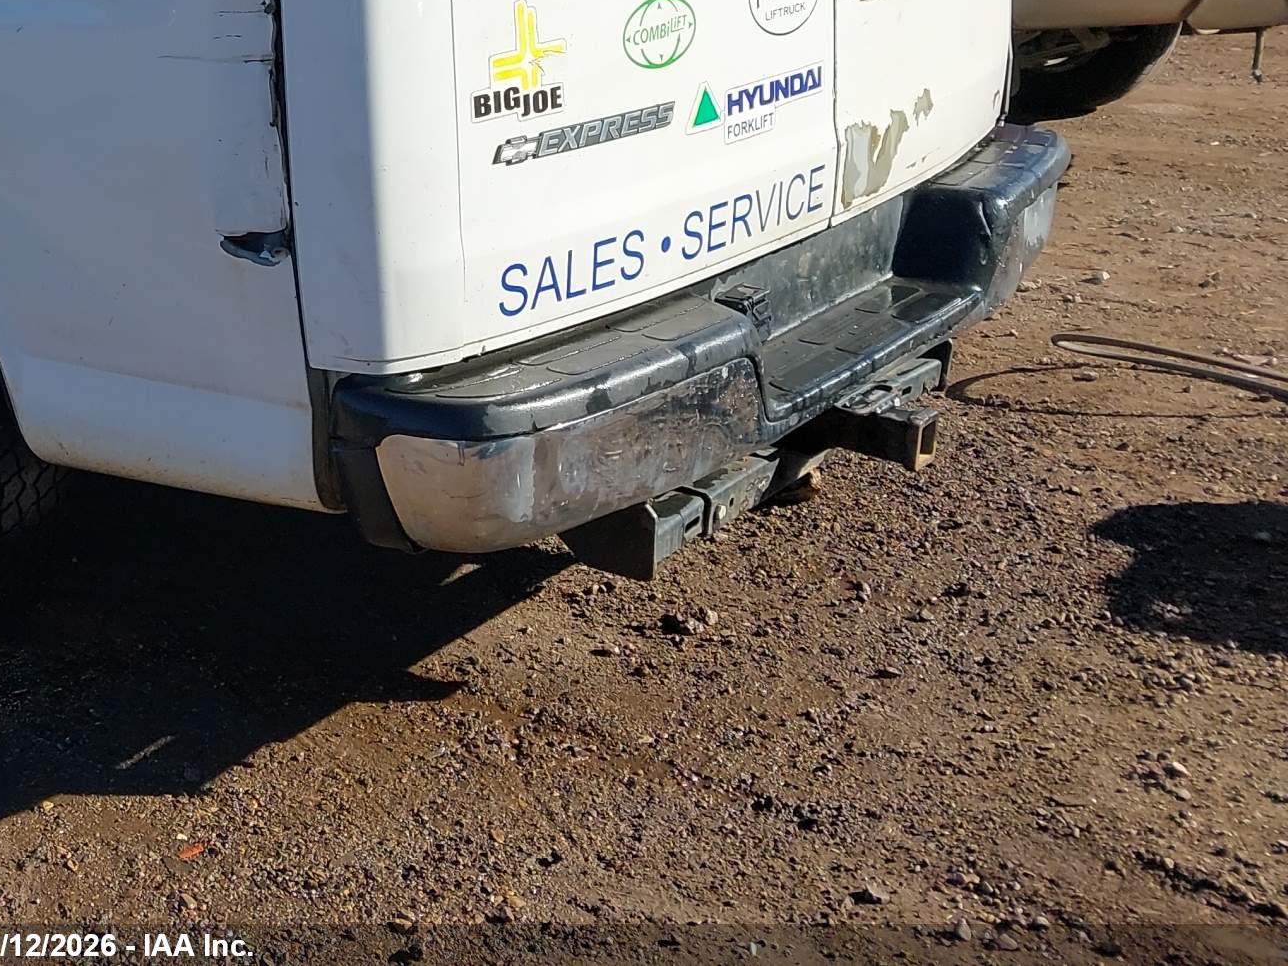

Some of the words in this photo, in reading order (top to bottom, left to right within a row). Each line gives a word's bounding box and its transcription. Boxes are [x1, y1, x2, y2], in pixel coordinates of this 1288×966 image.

[764, 1, 807, 22] LIFTRUCK
[727, 66, 822, 117] HYUNDAI
[537, 101, 675, 158] EXPRESS
[727, 112, 775, 139] FORKLIFT
[498, 229, 646, 318] SALES
[681, 164, 826, 261] SERVICE
